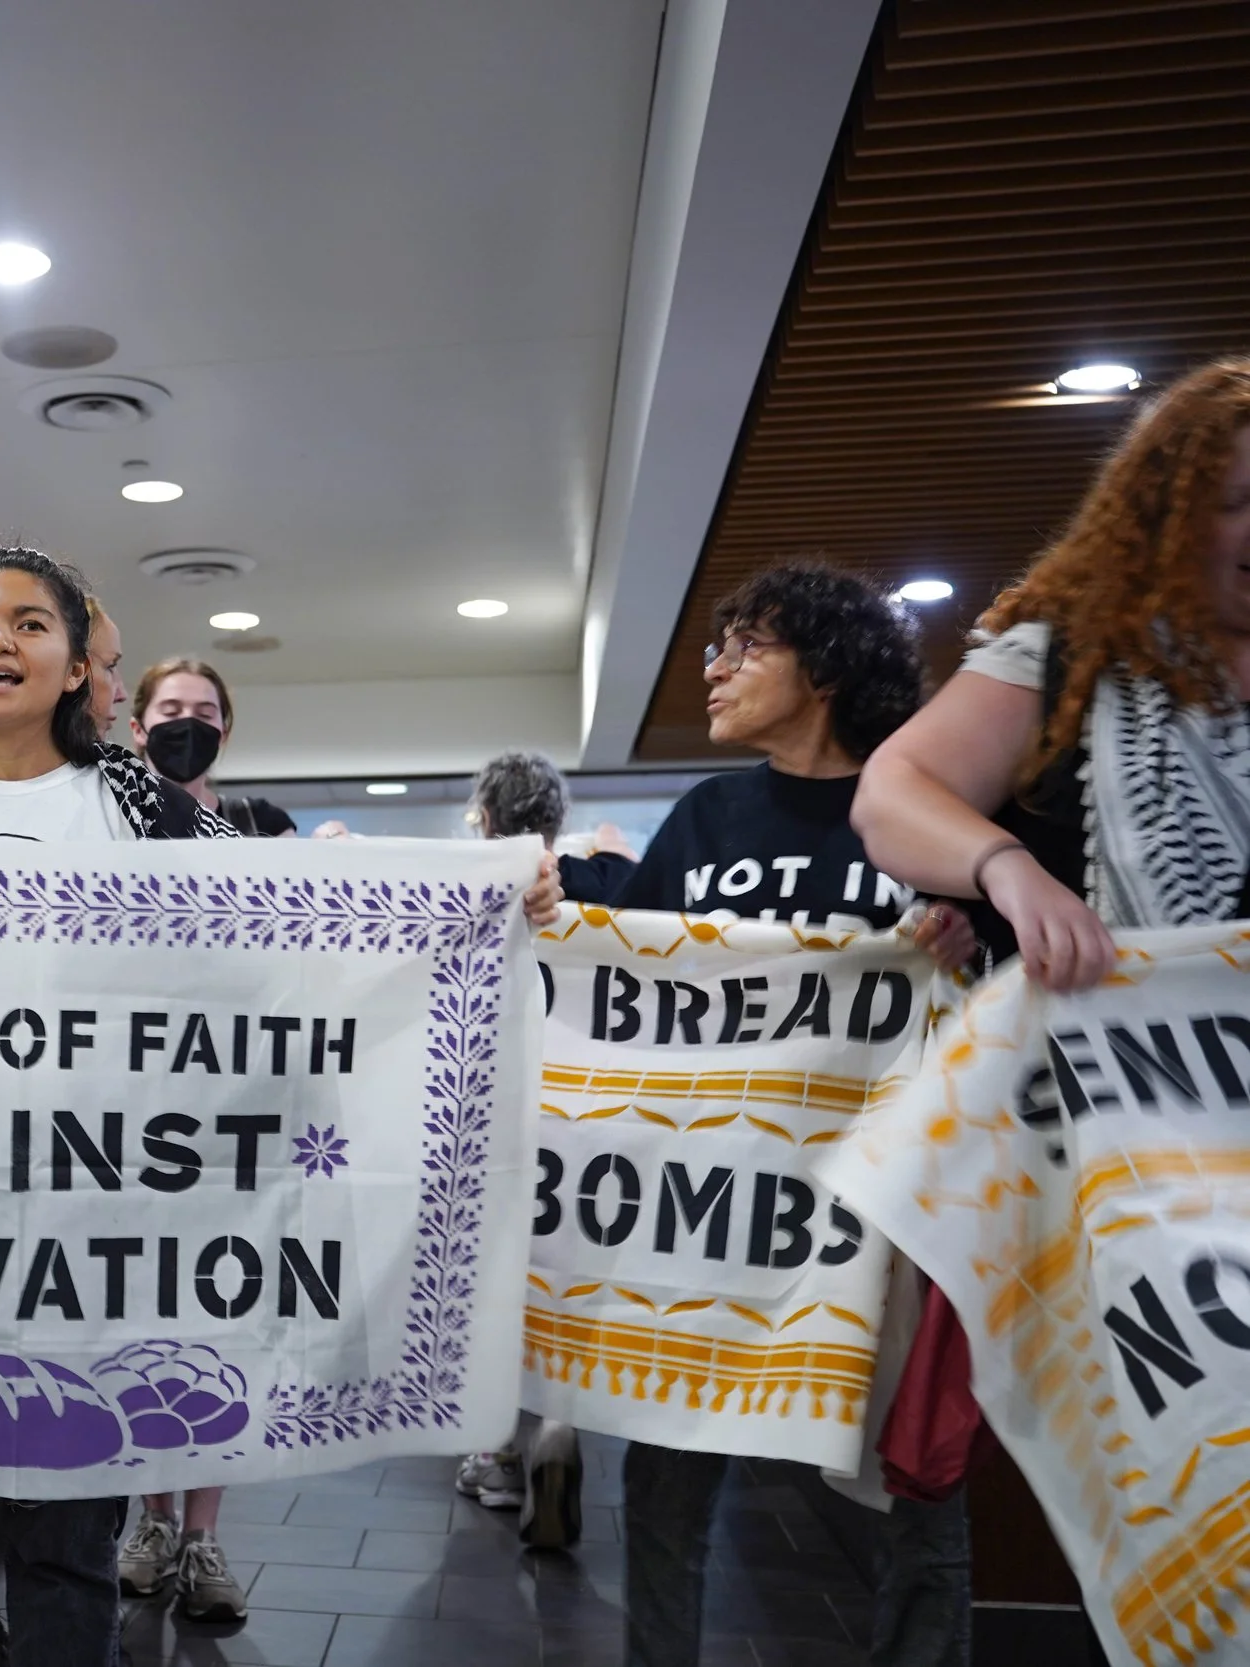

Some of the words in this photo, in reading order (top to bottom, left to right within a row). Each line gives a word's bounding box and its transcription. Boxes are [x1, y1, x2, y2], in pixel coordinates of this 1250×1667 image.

[684, 856, 812, 908] NOT
[843, 862, 916, 915] IN
[590, 964, 913, 1046] BREAD
[128, 1011, 358, 1076] FAITH
[531, 1148, 863, 1270] BOMBS
